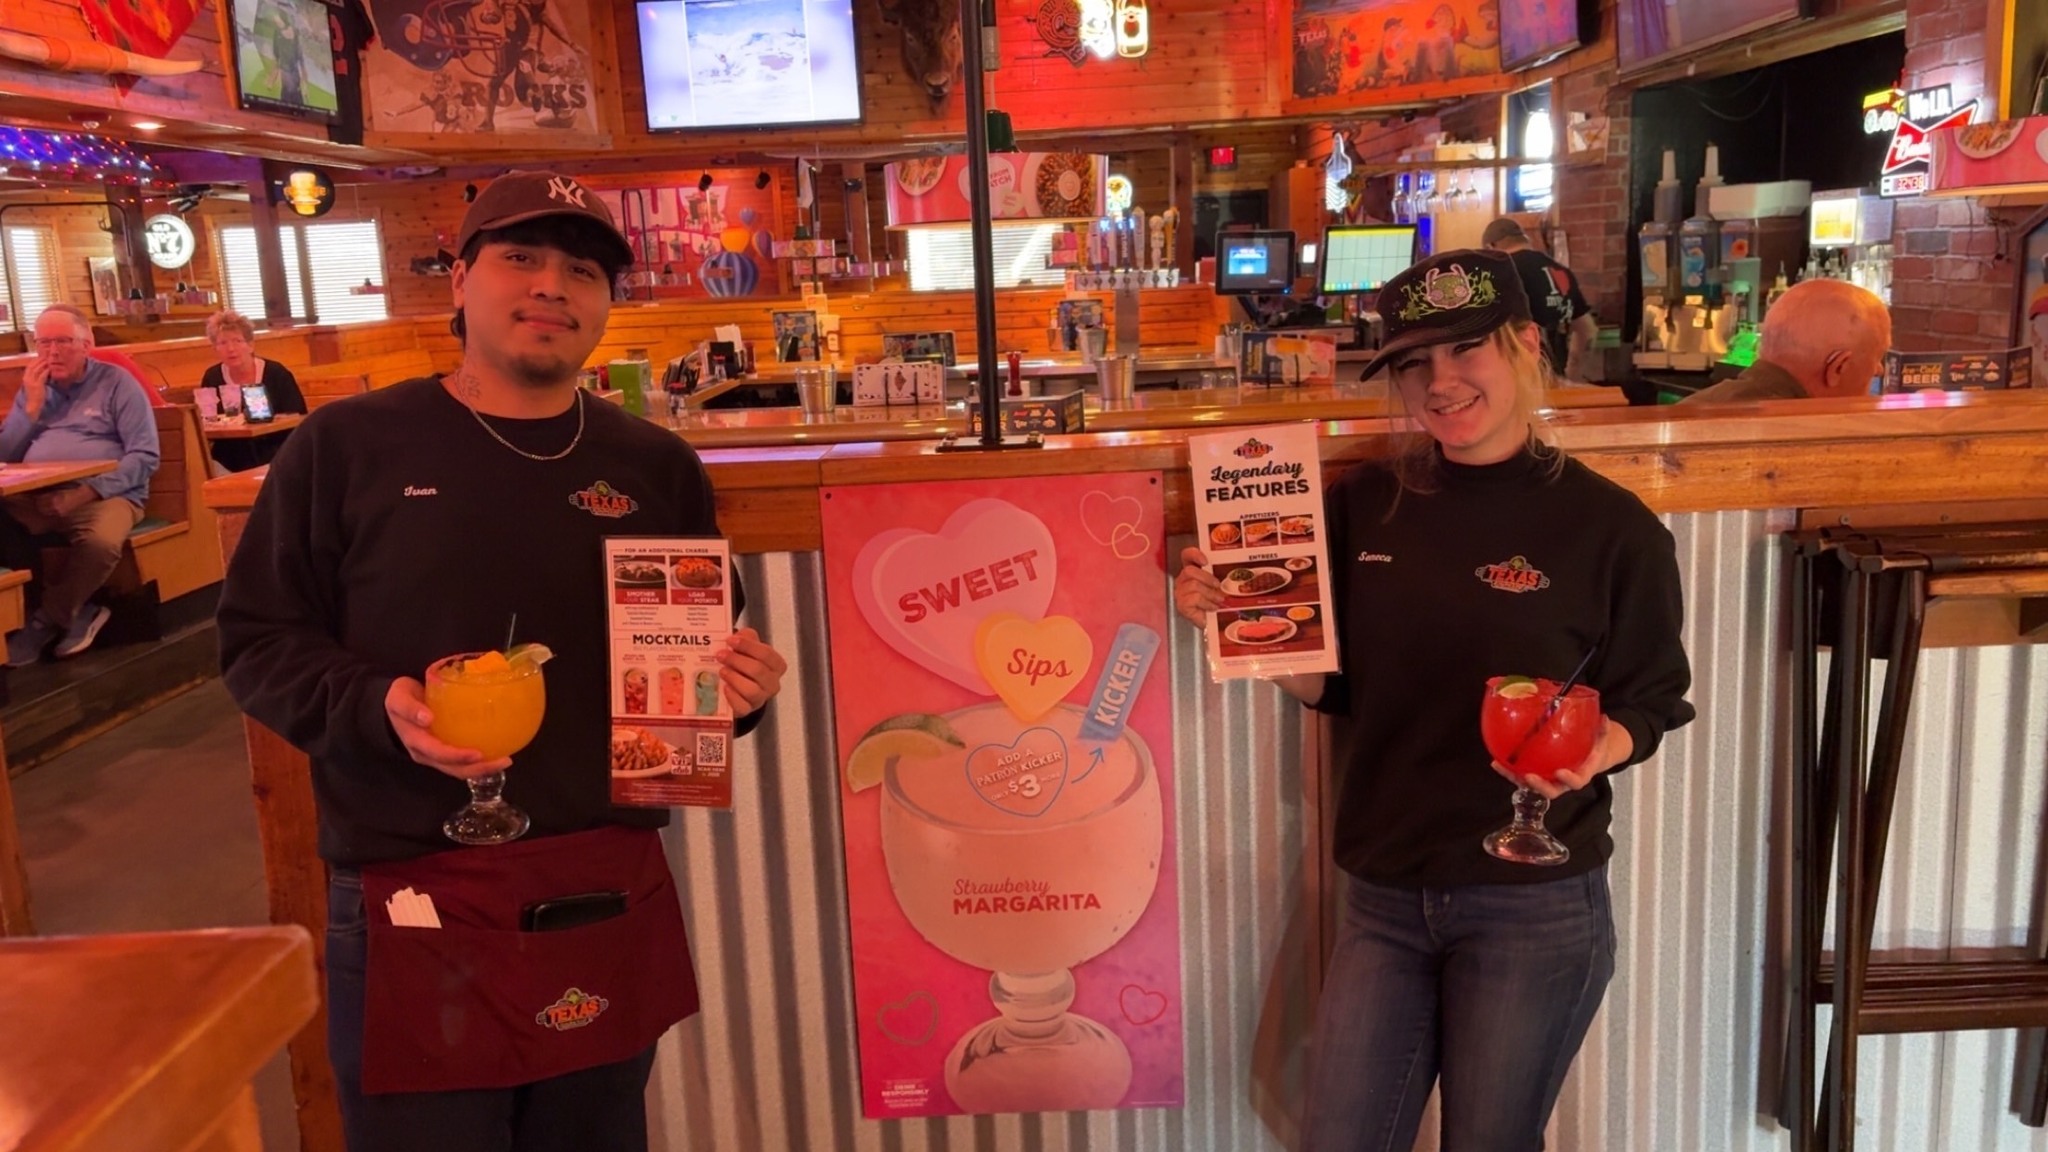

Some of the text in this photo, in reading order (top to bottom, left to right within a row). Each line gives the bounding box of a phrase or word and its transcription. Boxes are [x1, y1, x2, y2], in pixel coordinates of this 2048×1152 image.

[1299, 29, 1327, 44] TEXAS
[460, 81, 587, 109] ROCKS
[548, 176, 587, 208] NY
[1902, 374, 1941, 385] BEER
[1210, 460, 1304, 485] Legendary
[404, 485, 438, 497] Ivan
[1205, 479, 1310, 503] FEATURES
[580, 492, 630, 513] TEXAS
[1240, 511, 1280, 519] APPETIZERS
[899, 550, 1038, 623] SWEET
[1488, 566, 1539, 586] TEXAS
[632, 634, 711, 646] MOCKTAILS
[1006, 647, 1073, 686] Sips
[1094, 648, 1142, 726] KICKER
[997, 748, 1034, 767] ADD A
[1020, 751, 1062, 772] KICKER
[1008, 773, 1042, 797] $3
[953, 878, 1050, 897] Strawberry
[953, 893, 1102, 915] MARGARITA
[547, 1000, 599, 1024] TEXAS
